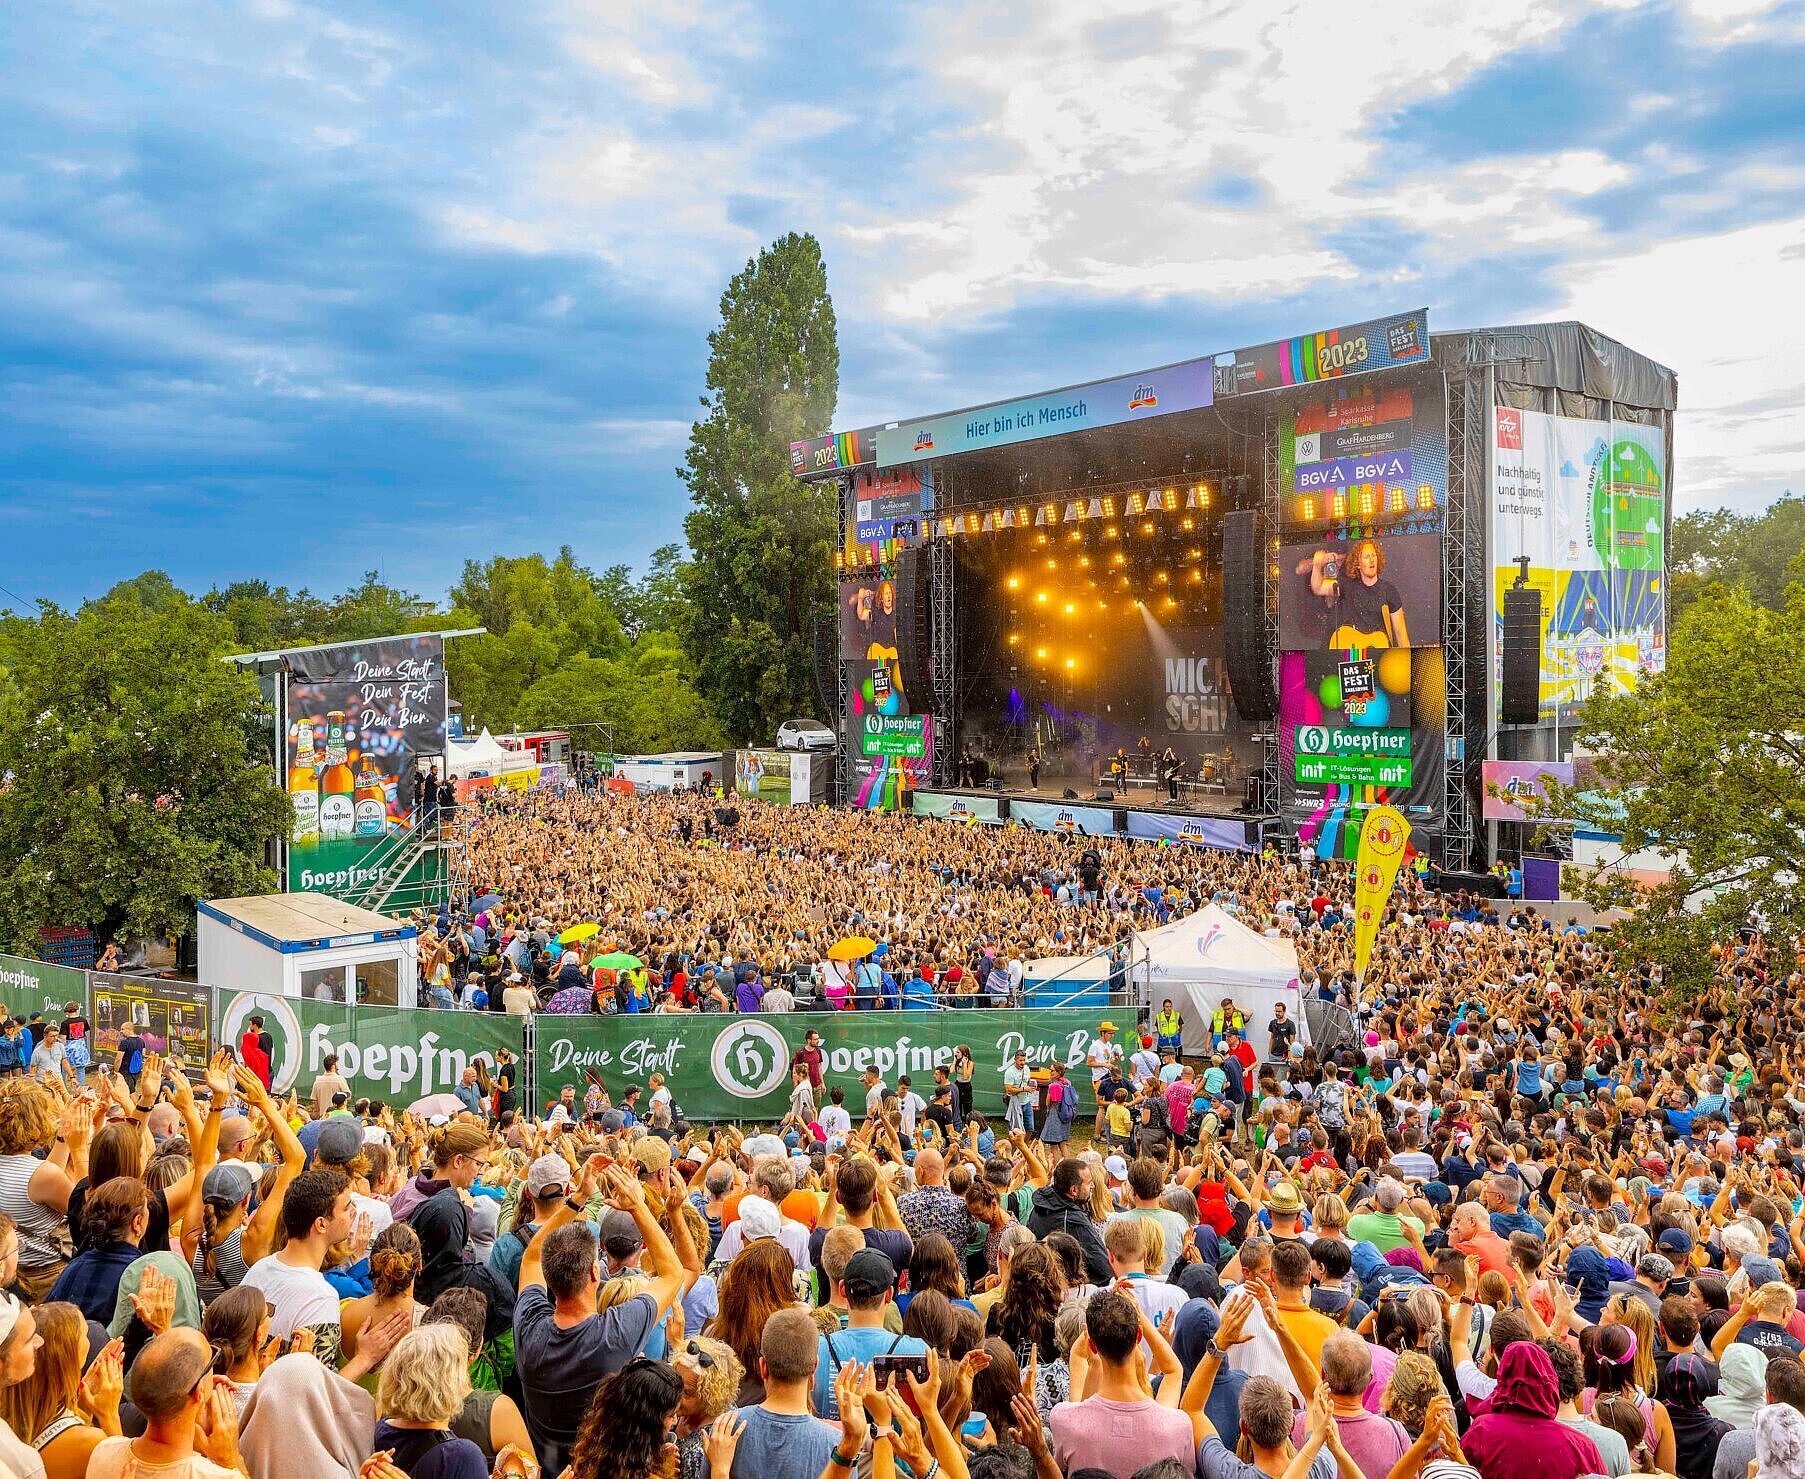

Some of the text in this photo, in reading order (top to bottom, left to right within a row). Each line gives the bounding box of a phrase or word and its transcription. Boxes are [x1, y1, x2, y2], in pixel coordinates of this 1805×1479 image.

[1390, 326, 1405, 338] DAS
[1390, 333, 1414, 348] FEST
[1320, 336, 1368, 372] 2023
[1134, 384, 1154, 400] dm
[966, 400, 1087, 438] Hier bin ich Mensch
[1340, 415, 1374, 426] Karlsruhe
[918, 430, 932, 444] dm
[814, 445, 838, 466] 2023
[1498, 465, 1540, 484] Nachhaltig
[1498, 484, 1516, 496] und
[1498, 504, 1544, 518] unterwegs.
[354, 658, 434, 682] Deine Stadt.
[1344, 666, 1360, 676] DAS
[875, 678, 888, 686] FEST
[1344, 675, 1370, 686] FEST
[361, 682, 434, 705] Dein Fest.
[1344, 702, 1366, 714] 2023
[360, 709, 392, 730] Dein
[398, 708, 430, 728] Bier.
[884, 718, 922, 732] hoepfner
[1333, 730, 1406, 751] hoepfner
[1302, 761, 1326, 778] init
[1380, 764, 1407, 782] init
[952, 798, 966, 811] dm
[1301, 799, 1324, 810] SWR3
[324, 812, 351, 820] hoepfner
[1058, 808, 1074, 824] dm
[1182, 820, 1202, 836] dm
[301, 866, 387, 890] hoepfner
[550, 1038, 613, 1073] Deine
[620, 1037, 686, 1077] Stadt.
[996, 1031, 1058, 1072] Dein
